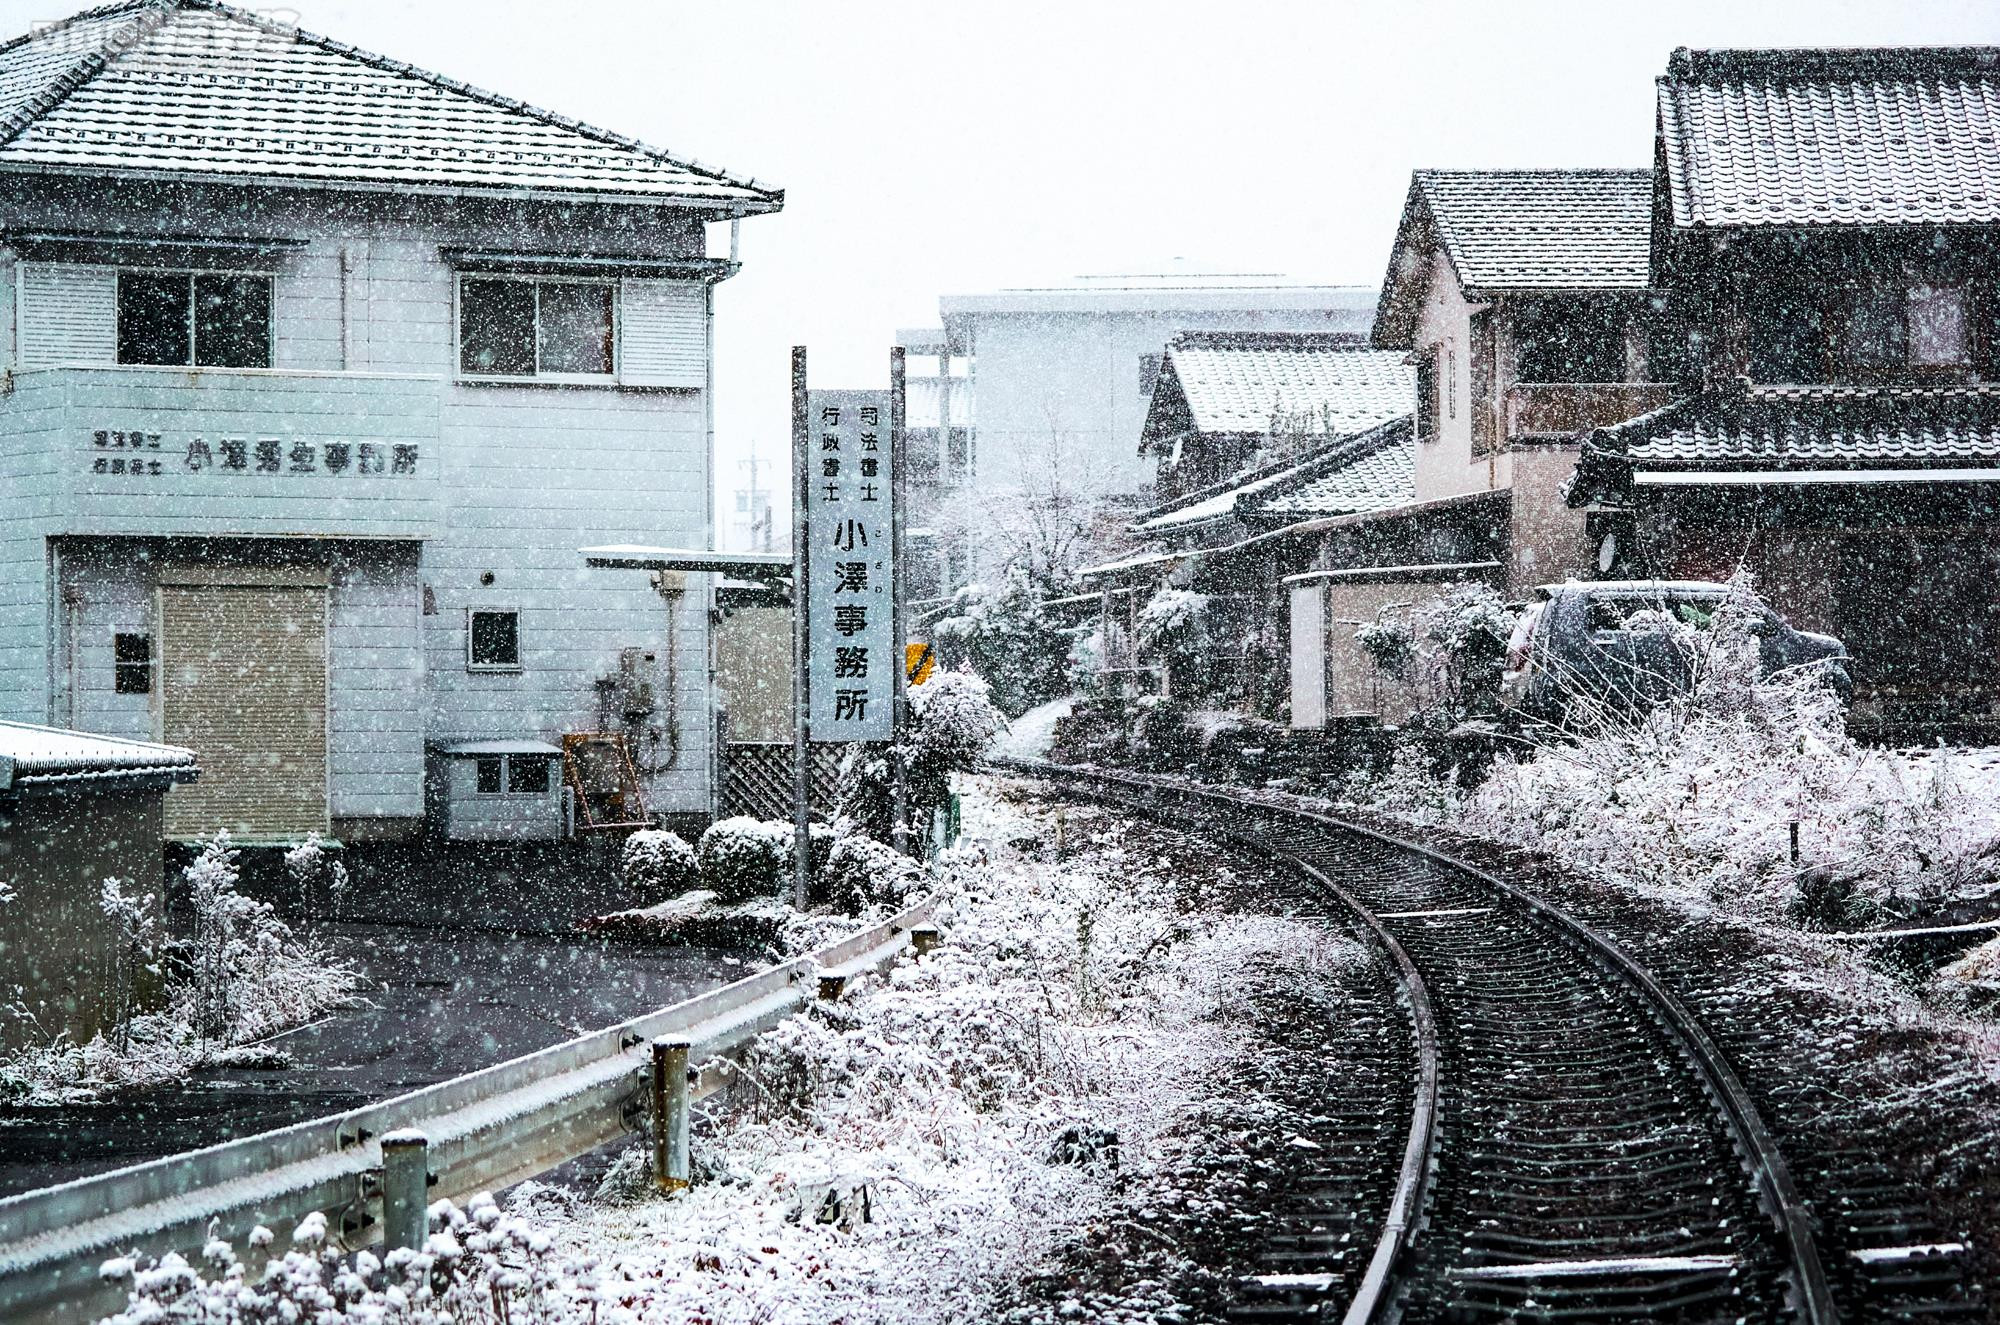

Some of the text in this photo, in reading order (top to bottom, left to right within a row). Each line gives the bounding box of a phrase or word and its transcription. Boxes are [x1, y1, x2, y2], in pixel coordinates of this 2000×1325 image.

[821, 407, 841, 502] 行政書士
[860, 407, 879, 502] 司法書士
[833, 518, 869, 722] 小澤事務所
